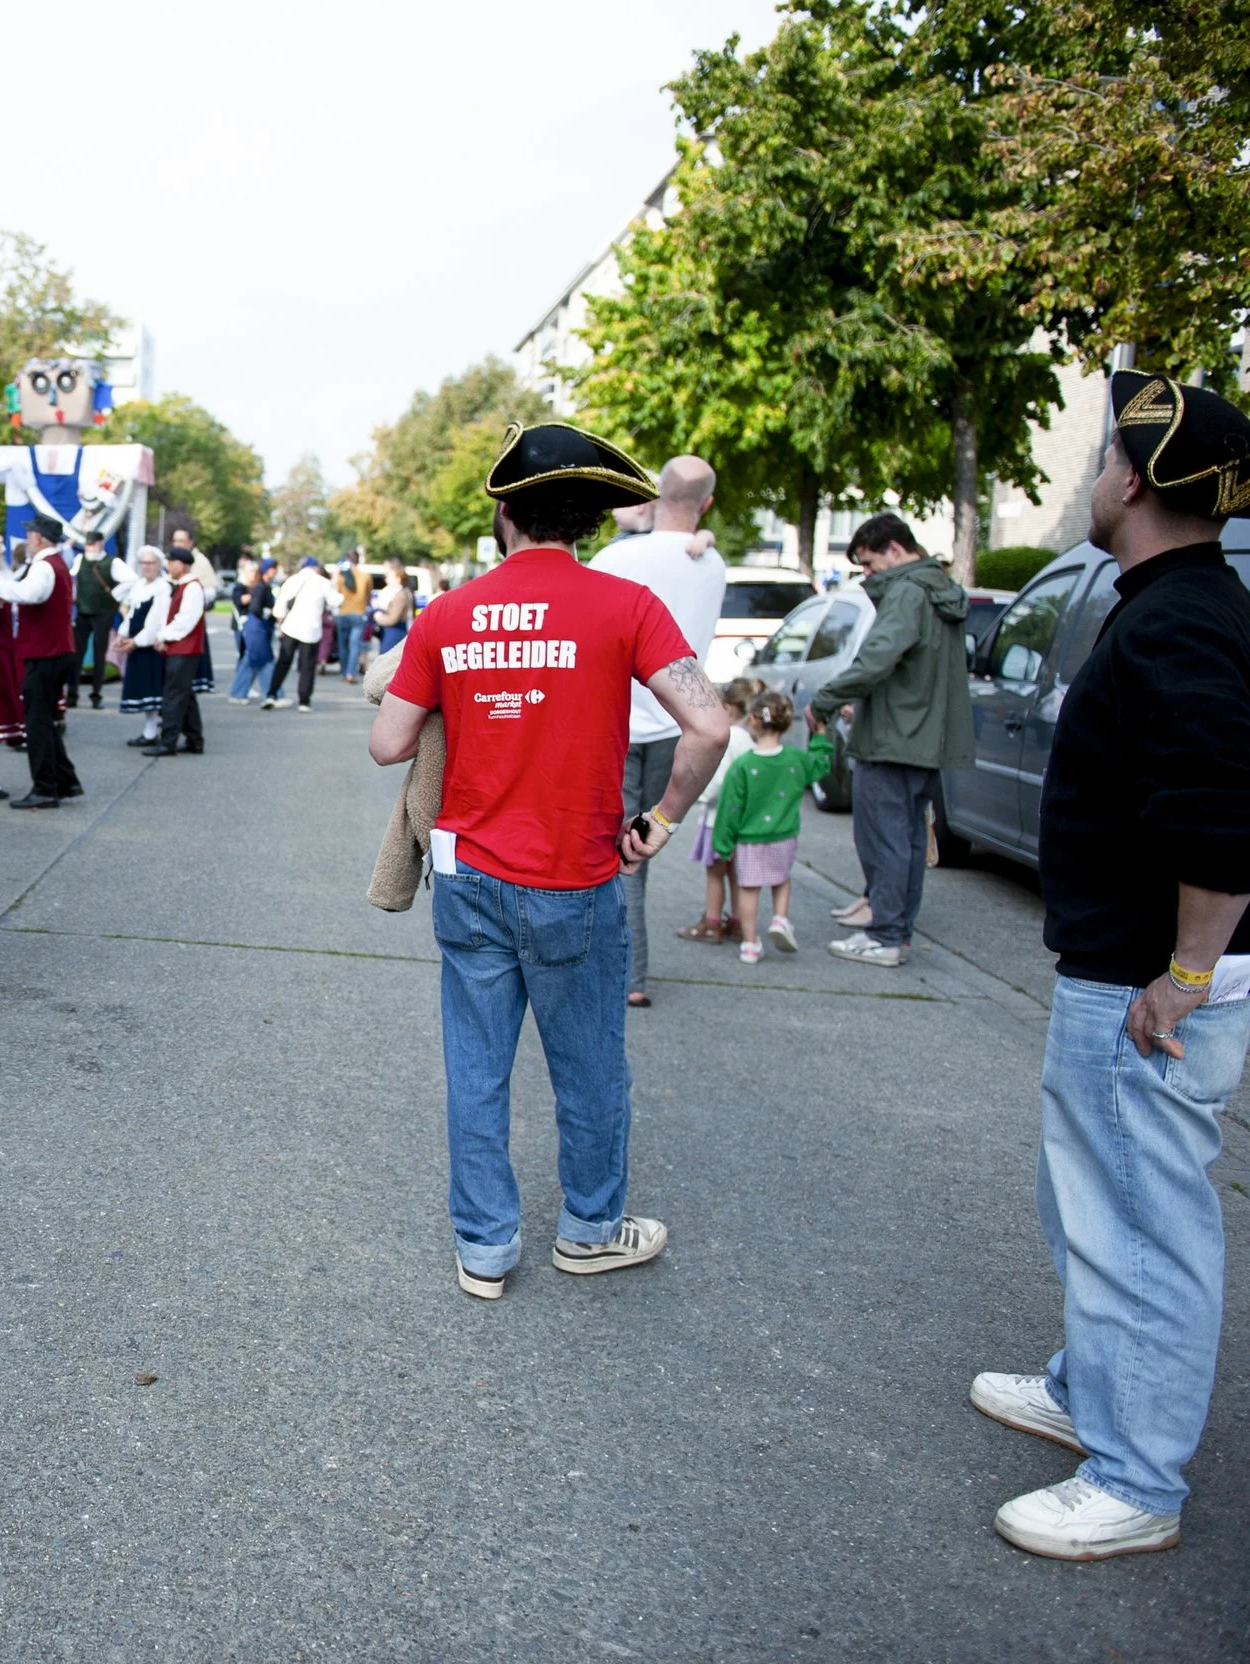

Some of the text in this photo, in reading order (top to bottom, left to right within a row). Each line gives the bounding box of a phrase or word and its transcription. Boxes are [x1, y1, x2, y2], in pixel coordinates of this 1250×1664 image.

[471, 602, 549, 632] STOET
[441, 640, 577, 674] BEGELEIDER
[474, 691, 523, 702] Carrefour
